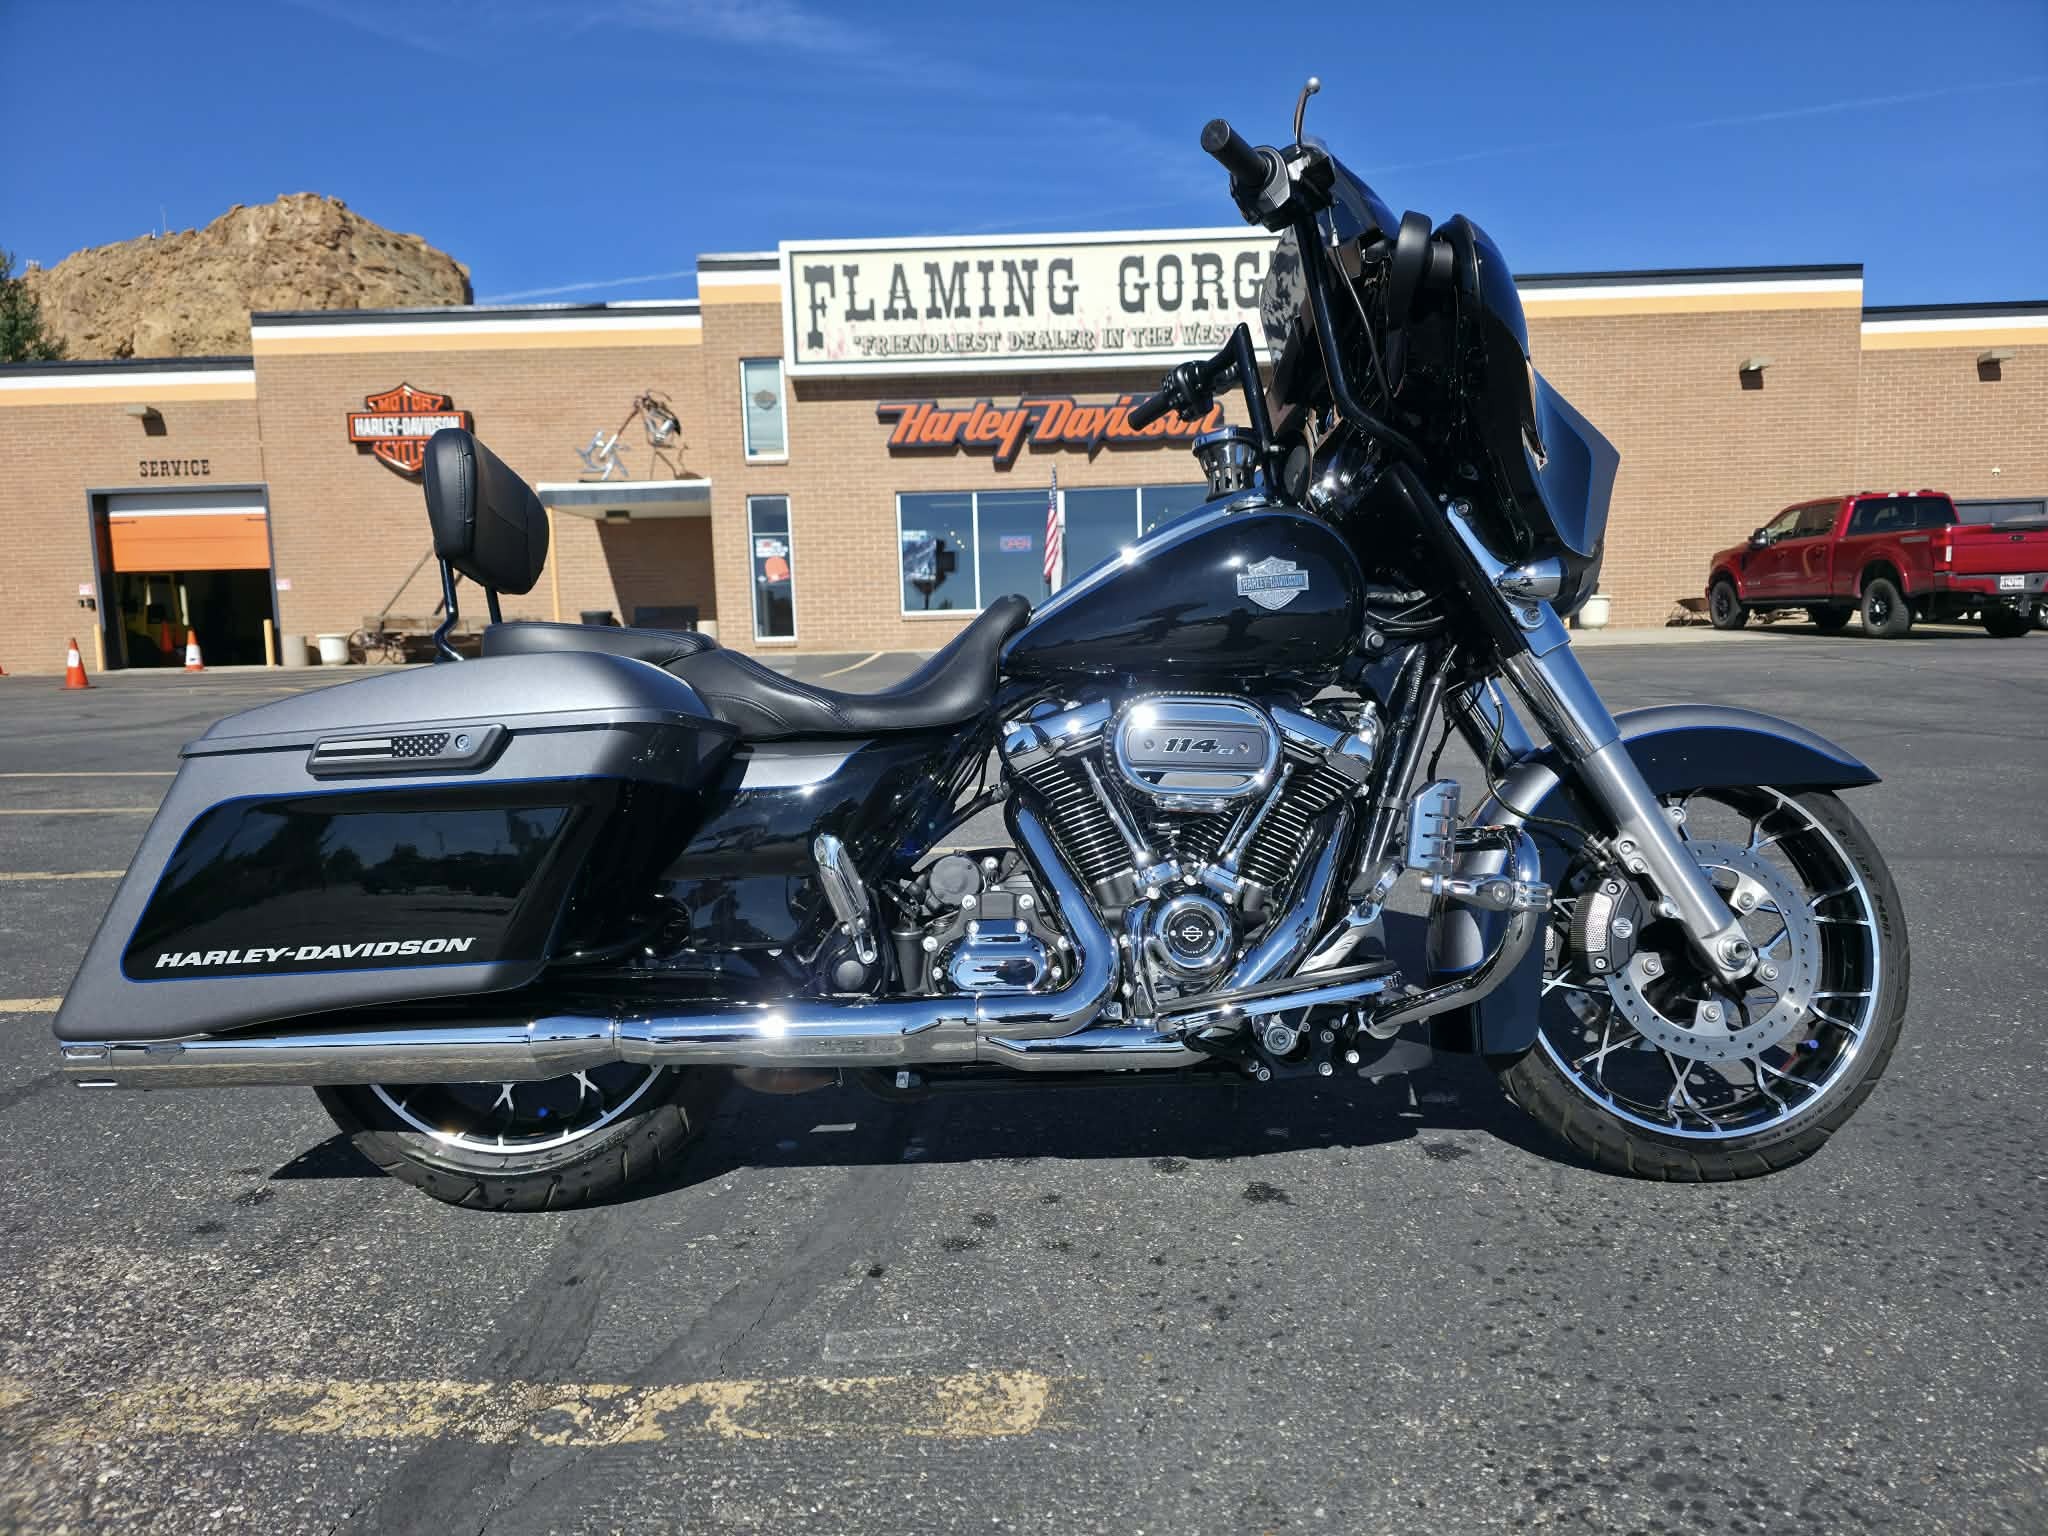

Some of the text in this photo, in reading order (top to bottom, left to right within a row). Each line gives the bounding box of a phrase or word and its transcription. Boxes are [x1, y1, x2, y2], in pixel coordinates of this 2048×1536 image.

[804, 251, 1275, 349] FLAMING GORG
[1008, 328, 1096, 352] DEALER
[1101, 327, 1126, 349] IN
[1131, 325, 1175, 347] THE
[378, 395, 433, 412] MOTOR
[382, 441, 424, 466] CYCLE
[139, 459, 211, 477] SERVICE
[154, 938, 475, 968] HARLEY-DAVIDSON
